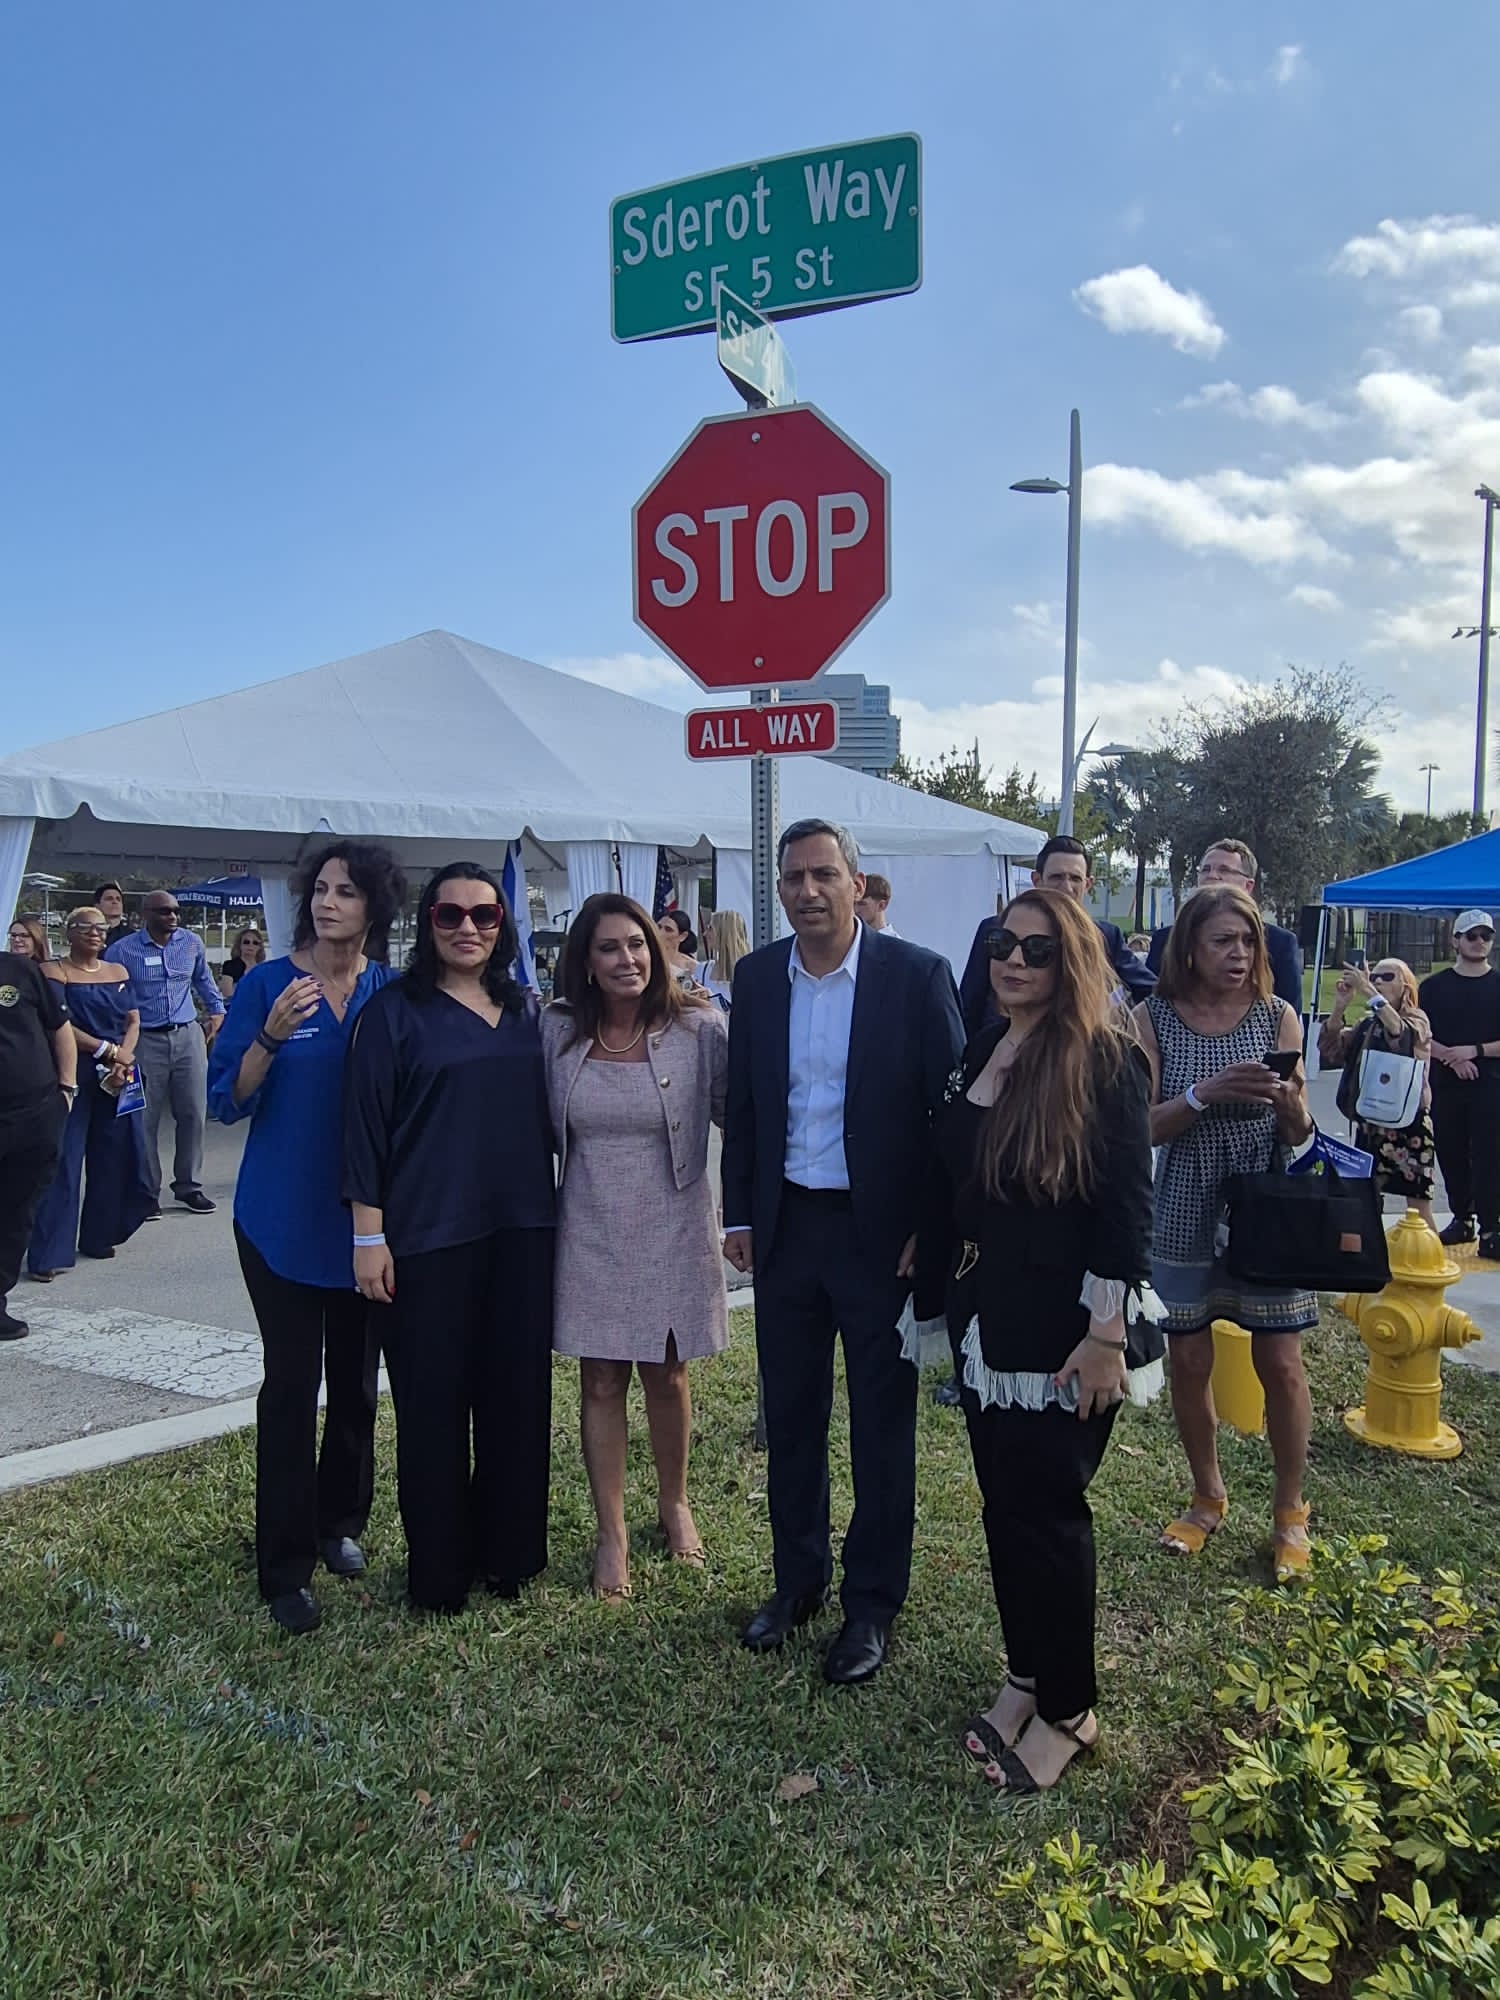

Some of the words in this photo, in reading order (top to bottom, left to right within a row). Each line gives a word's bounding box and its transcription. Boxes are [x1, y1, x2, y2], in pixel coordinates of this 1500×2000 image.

[622, 175, 771, 266] Sderot
[804, 160, 906, 231] Way
[751, 256, 772, 299] 5
[795, 245, 834, 290] St
[651, 491, 870, 608] STOP
[700, 718, 749, 750] ALL
[767, 712, 822, 745] WAY
[229, 863, 248, 873] EXIT
